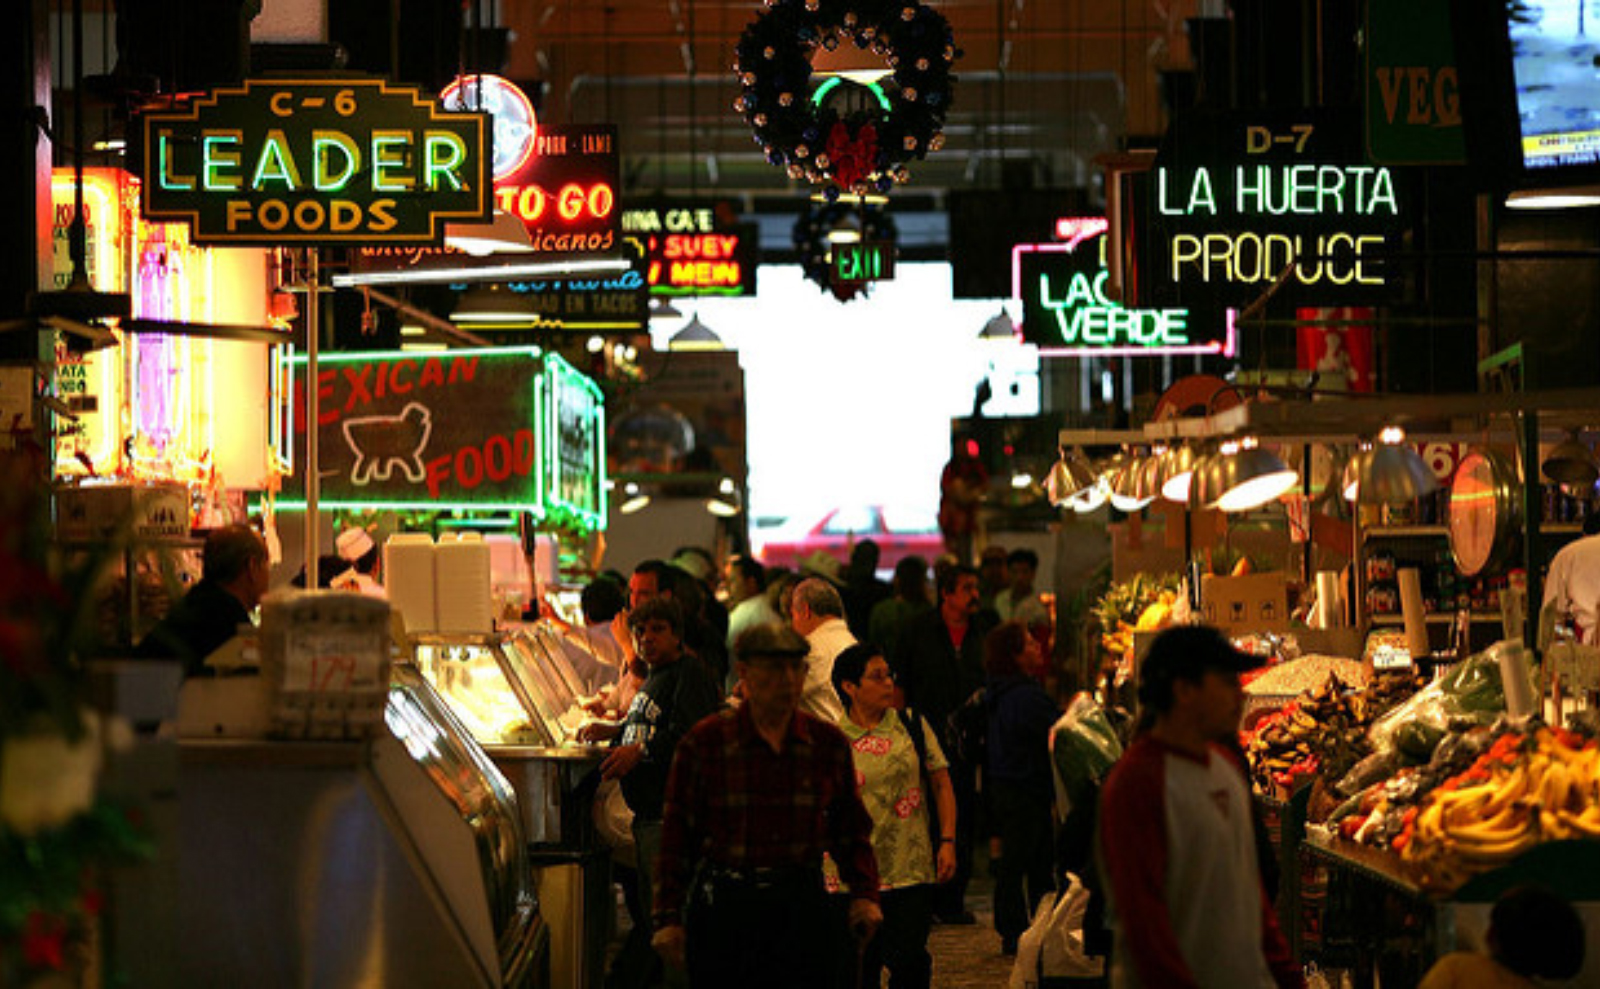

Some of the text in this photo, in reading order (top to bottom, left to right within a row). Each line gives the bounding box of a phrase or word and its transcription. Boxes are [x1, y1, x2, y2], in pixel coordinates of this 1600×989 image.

[270, 90, 357, 117] C-6
[1375, 66, 1463, 127] VEG
[1246, 124, 1315, 154] D-7
[159, 129, 471, 192] LEADER
[495, 182, 614, 221] TO GO
[1158, 164, 1399, 216] LA HUERTA
[226, 199, 398, 231] FOODS
[663, 235, 739, 260] SUEY
[1171, 232, 1386, 286] PRODUCE
[670, 260, 741, 286] MEIN
[1055, 307, 1189, 344] VERDE
[425, 428, 536, 499] FOOD
